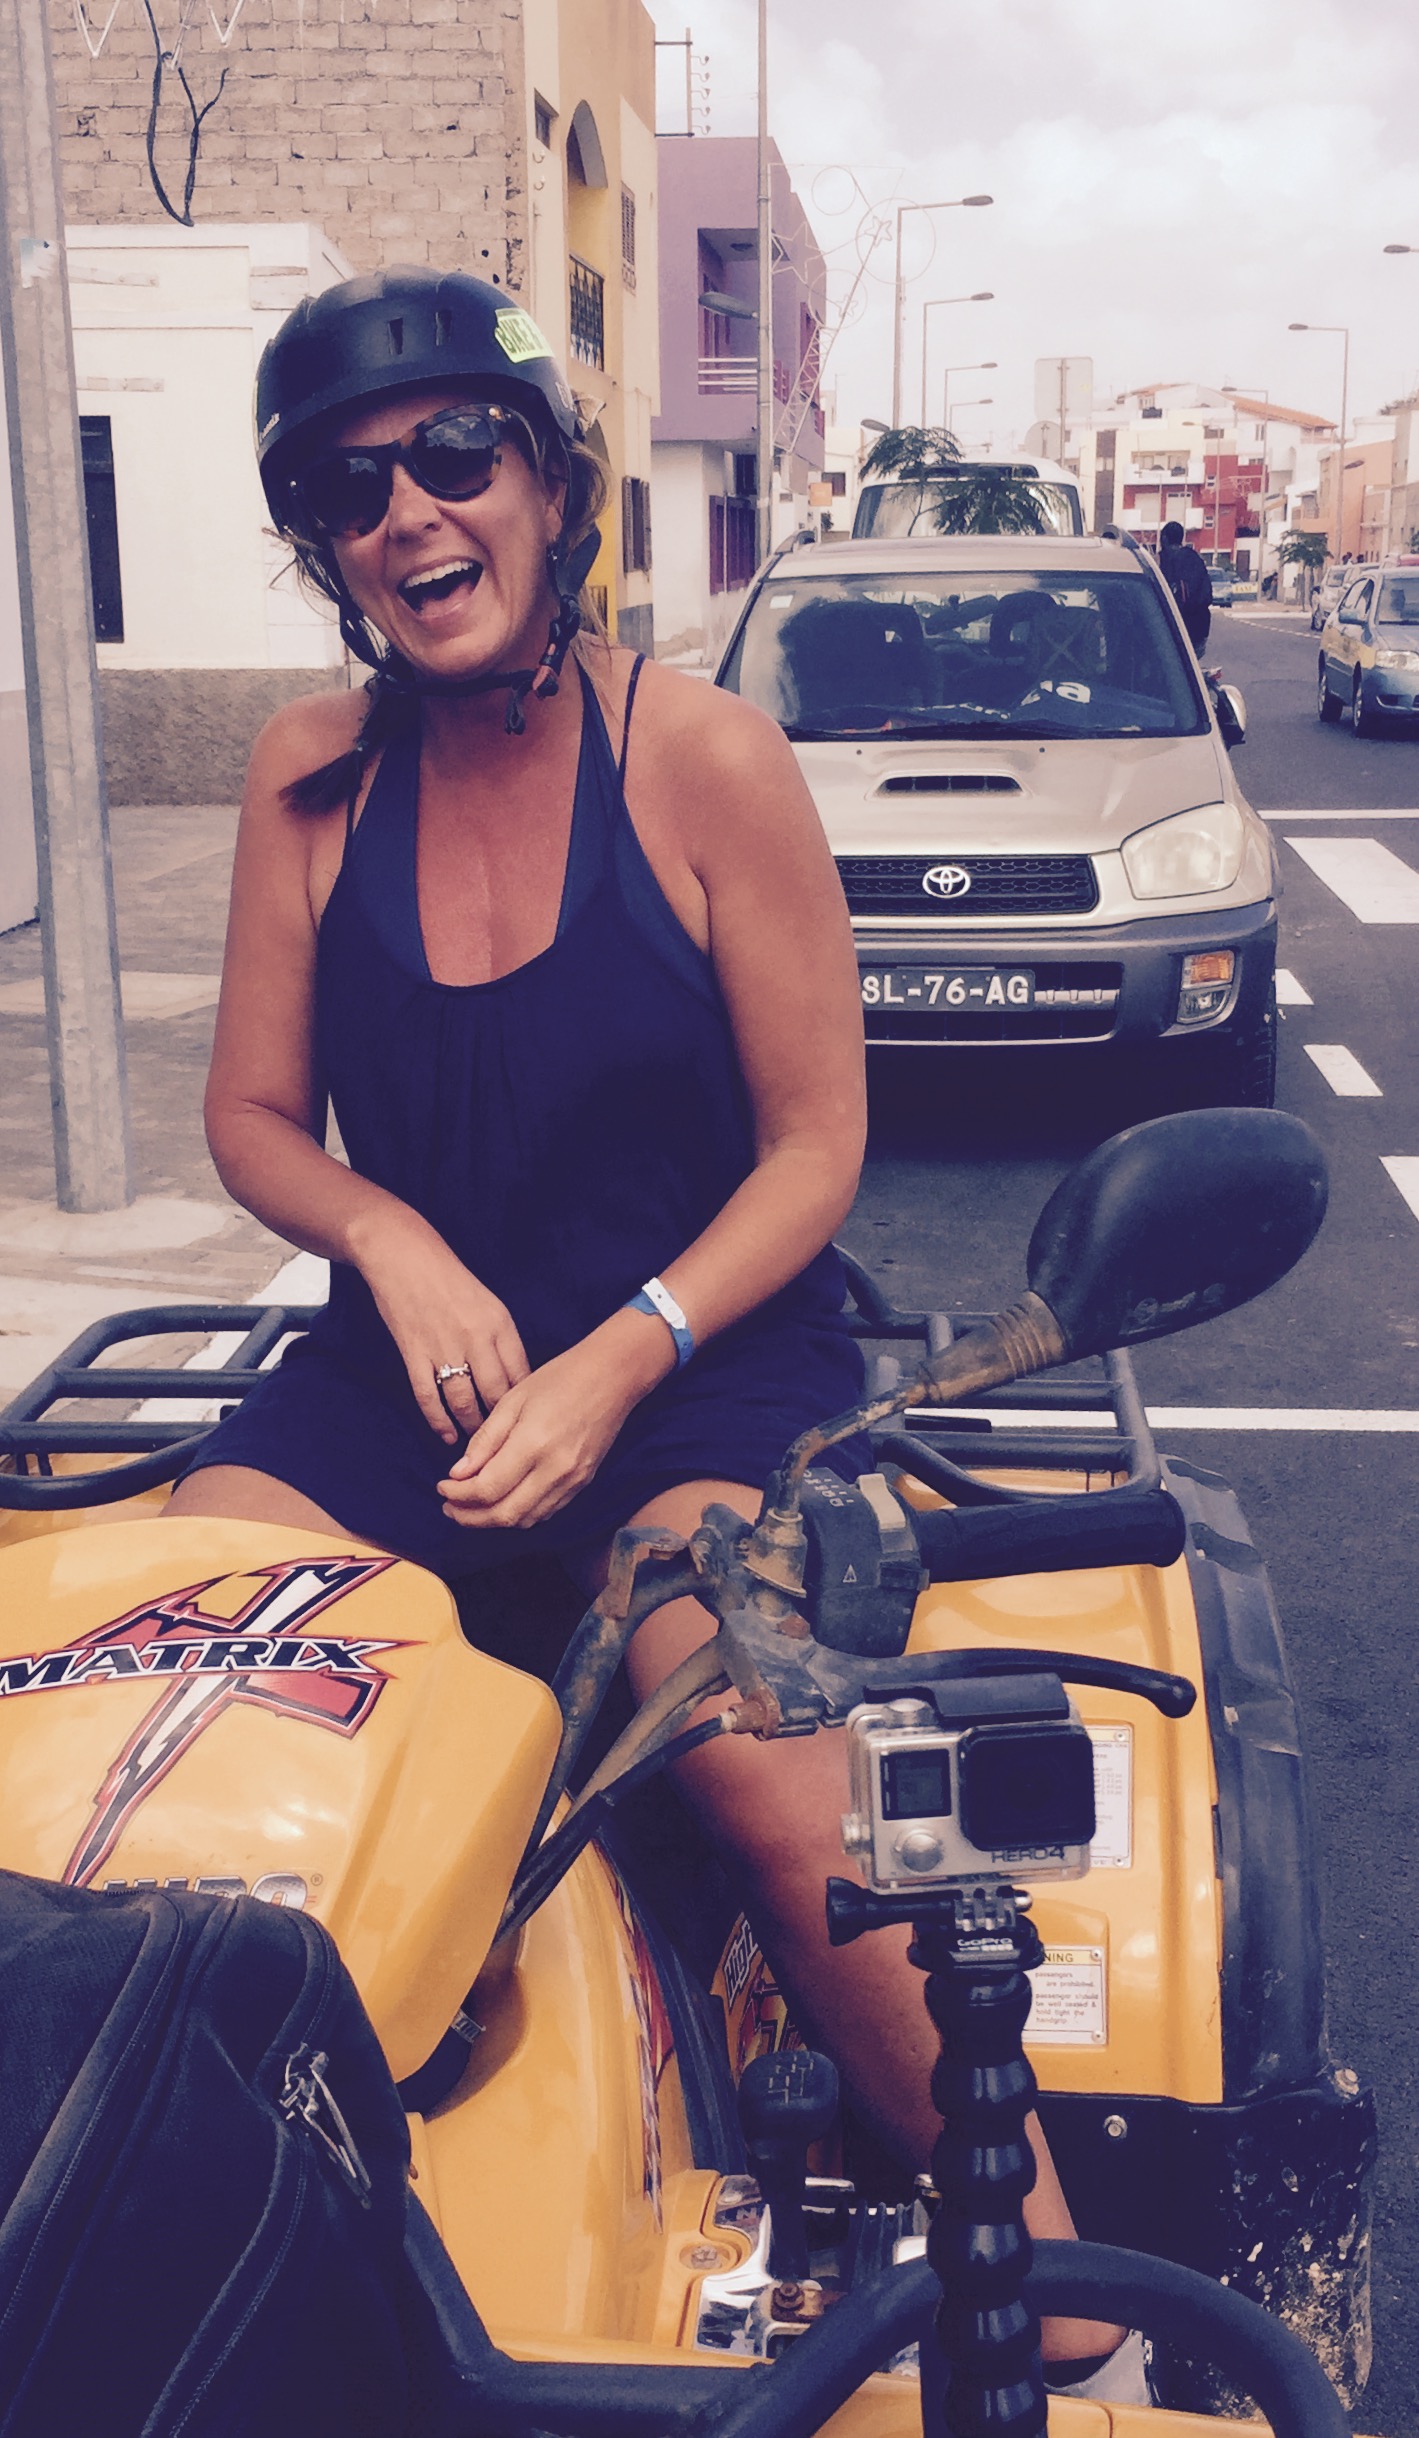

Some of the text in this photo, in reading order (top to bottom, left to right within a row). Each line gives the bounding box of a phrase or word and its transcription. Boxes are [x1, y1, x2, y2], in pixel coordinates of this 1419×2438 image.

[861, 975, 1029, 1005] SL-76-AG
[0, 1636, 392, 1695] MATRIX
[991, 1846, 1065, 1863] HERO4
[957, 1938, 1013, 1946] GoPro
